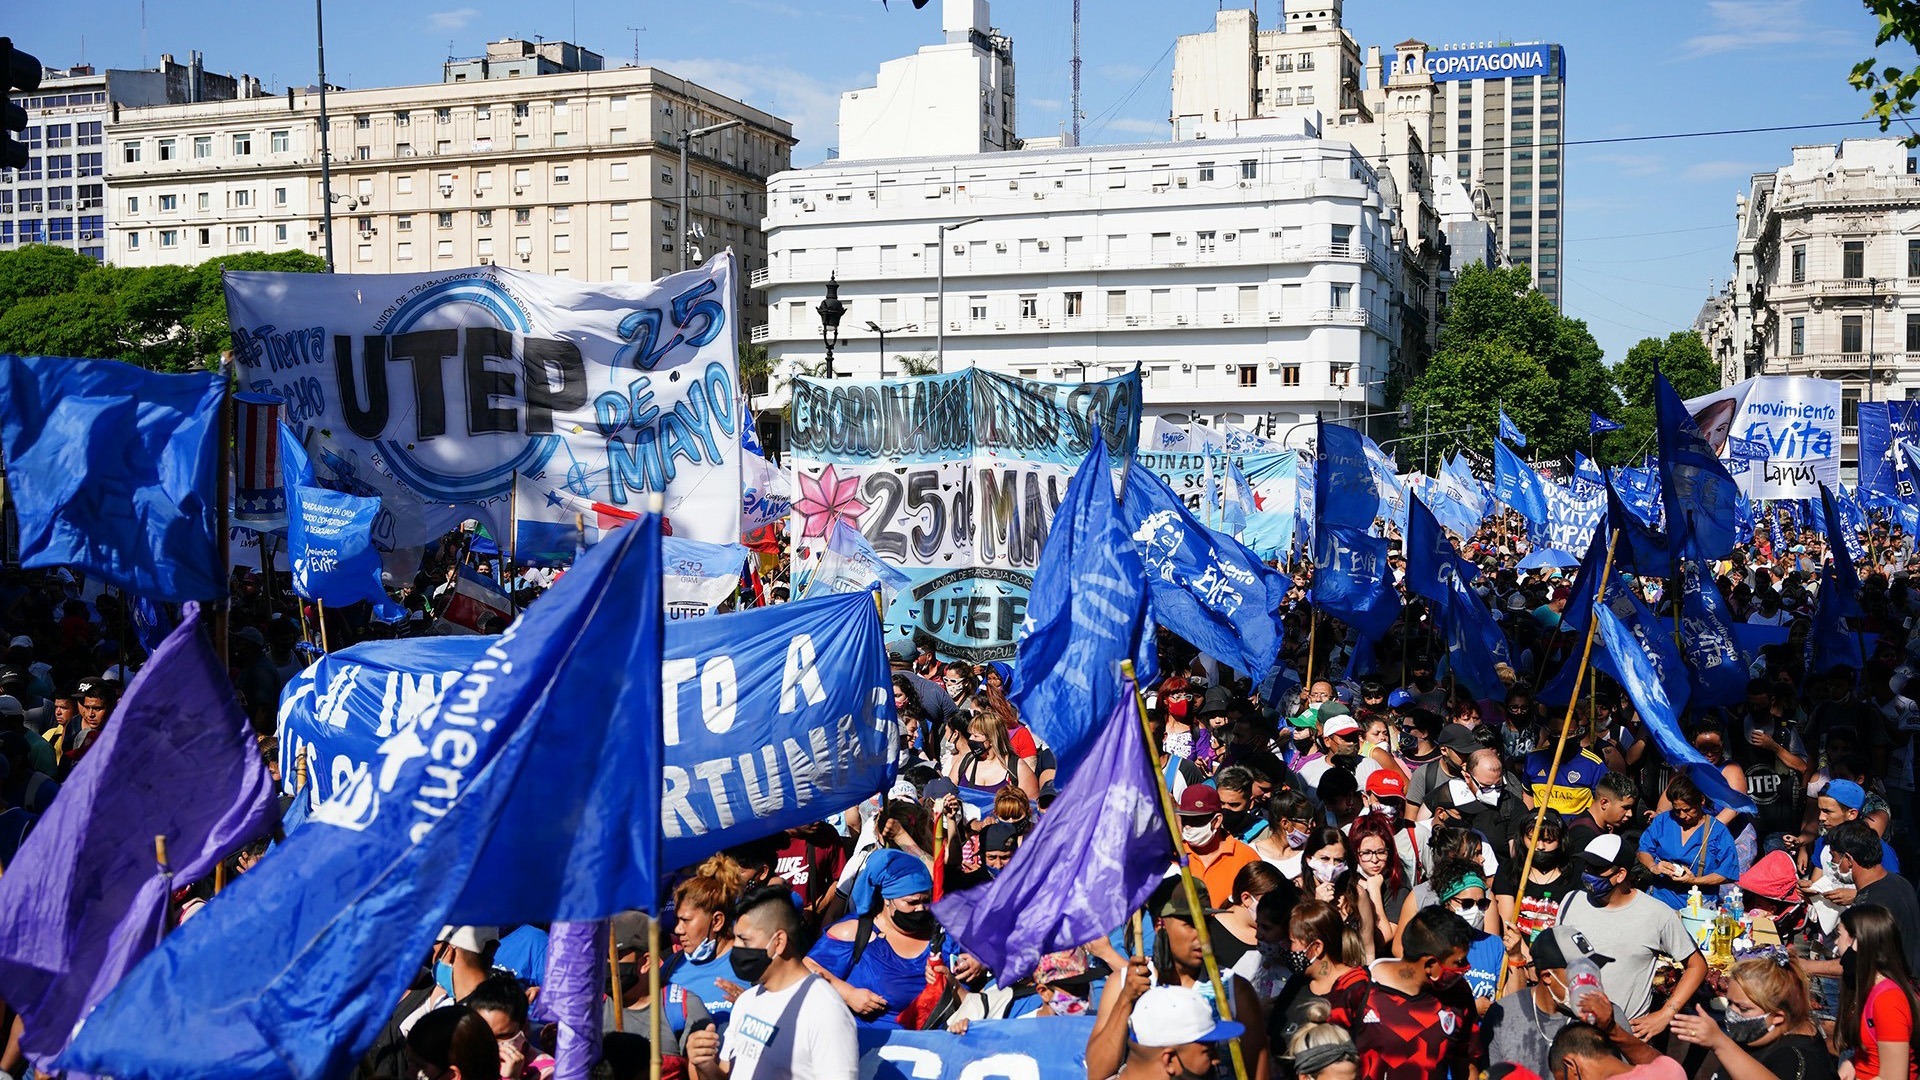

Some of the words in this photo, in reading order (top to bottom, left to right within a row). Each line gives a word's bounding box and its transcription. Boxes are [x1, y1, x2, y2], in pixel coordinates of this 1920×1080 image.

[1391, 52, 1543, 76] BCOPATAGONIA
[373, 305, 398, 331] UNION
[396, 295, 408, 309] DE
[408, 272, 478, 297] TRABAJADORES
[616, 278, 727, 370] 25
[334, 327, 588, 440] UTEP
[593, 376, 660, 436] DE
[1748, 400, 1835, 421] movimiento
[606, 361, 735, 505] MAYO
[371, 452, 384, 467] DE
[862, 471, 946, 563] 25
[834, 580, 859, 594] UTE
[922, 596, 1030, 641] UTEP
[983, 647, 1018, 660] POPULA
[774, 856, 804, 874] IKE
[792, 871, 810, 885] SB
[740, 1016, 775, 1042] POINT
